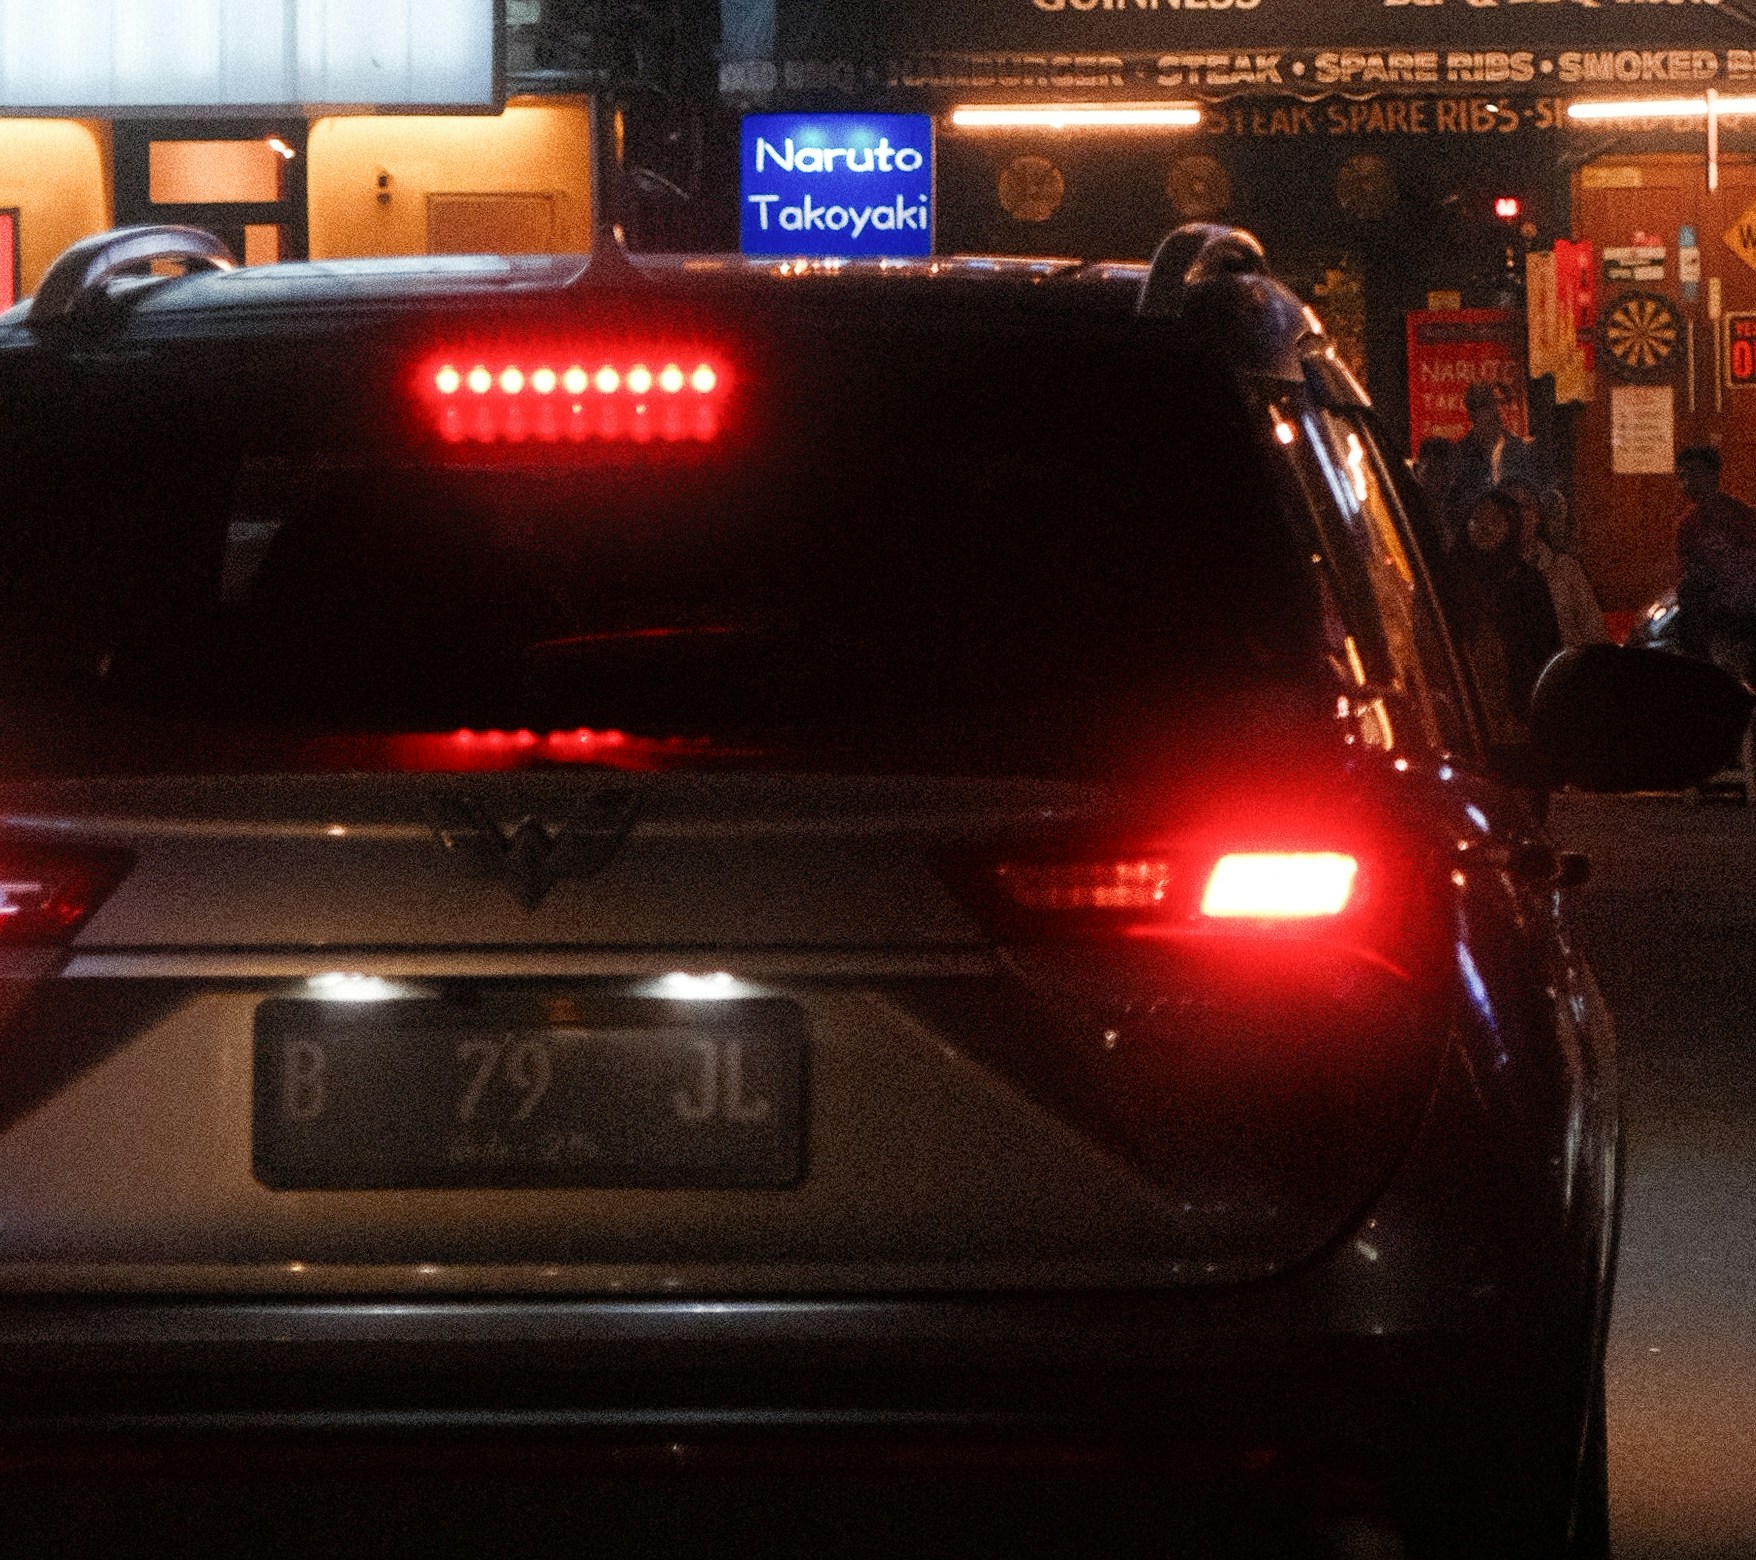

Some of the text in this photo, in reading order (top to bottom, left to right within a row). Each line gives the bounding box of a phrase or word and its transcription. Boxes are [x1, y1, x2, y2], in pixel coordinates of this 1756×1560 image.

[1156, 54, 1283, 86] STEAK
[1314, 51, 1439, 84] SPARE
[1447, 51, 1535, 83] RIBS
[1559, 50, 1719, 83] SMOKED
[1326, 100, 1429, 135] SPARE
[1435, 97, 1520, 133] RIBS
[755, 137, 924, 172] Naruto
[748, 194, 928, 239] Takoyaki
[284, 1038, 772, 1123] B 79 JL
